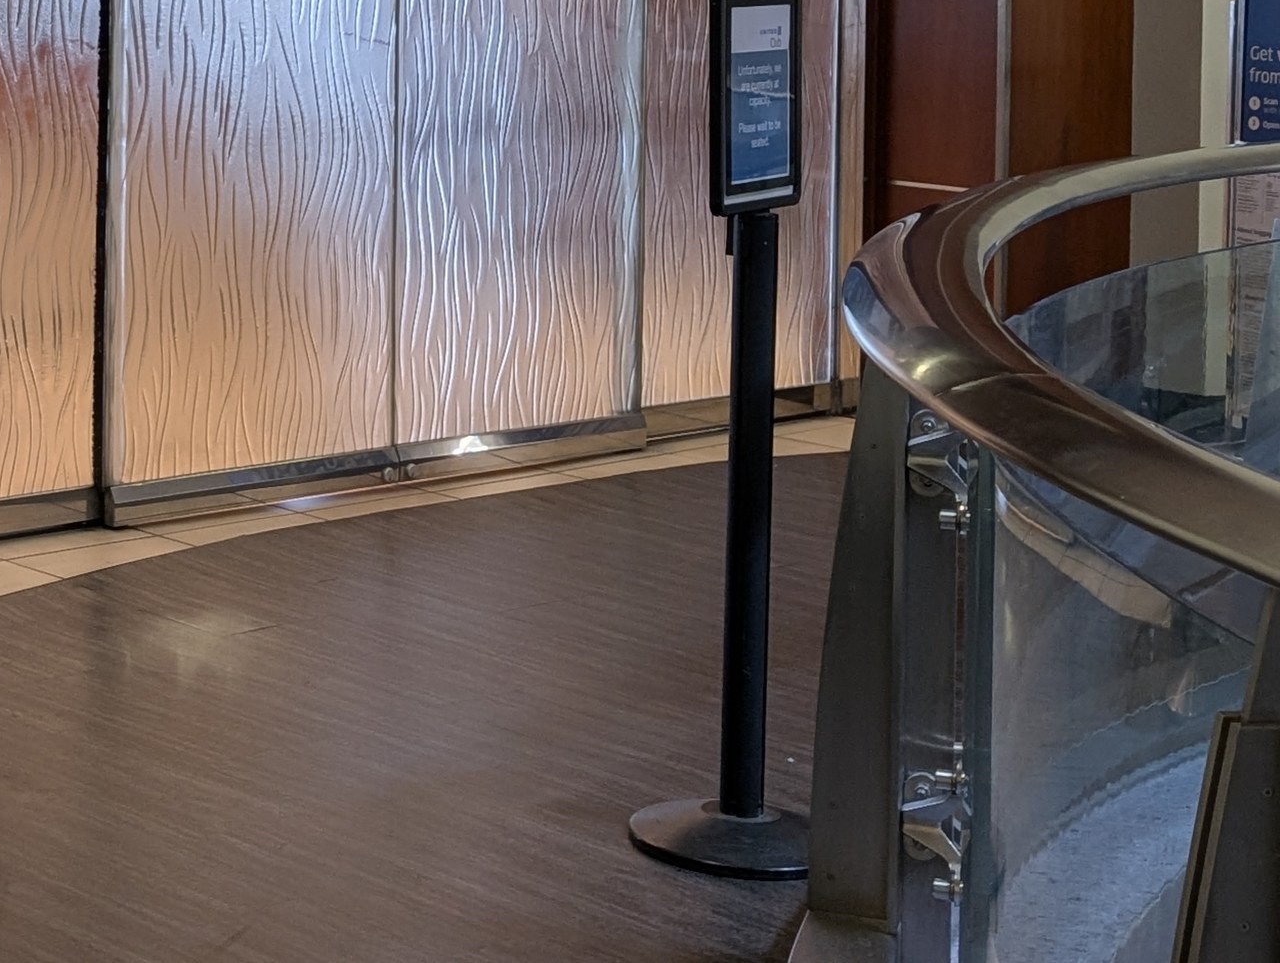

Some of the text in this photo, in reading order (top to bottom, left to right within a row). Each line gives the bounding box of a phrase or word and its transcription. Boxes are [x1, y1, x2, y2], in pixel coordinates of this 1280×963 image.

[1249, 45, 1274, 62] Get
[1249, 67, 1280, 84] from
[1263, 97, 1279, 106] Scan
